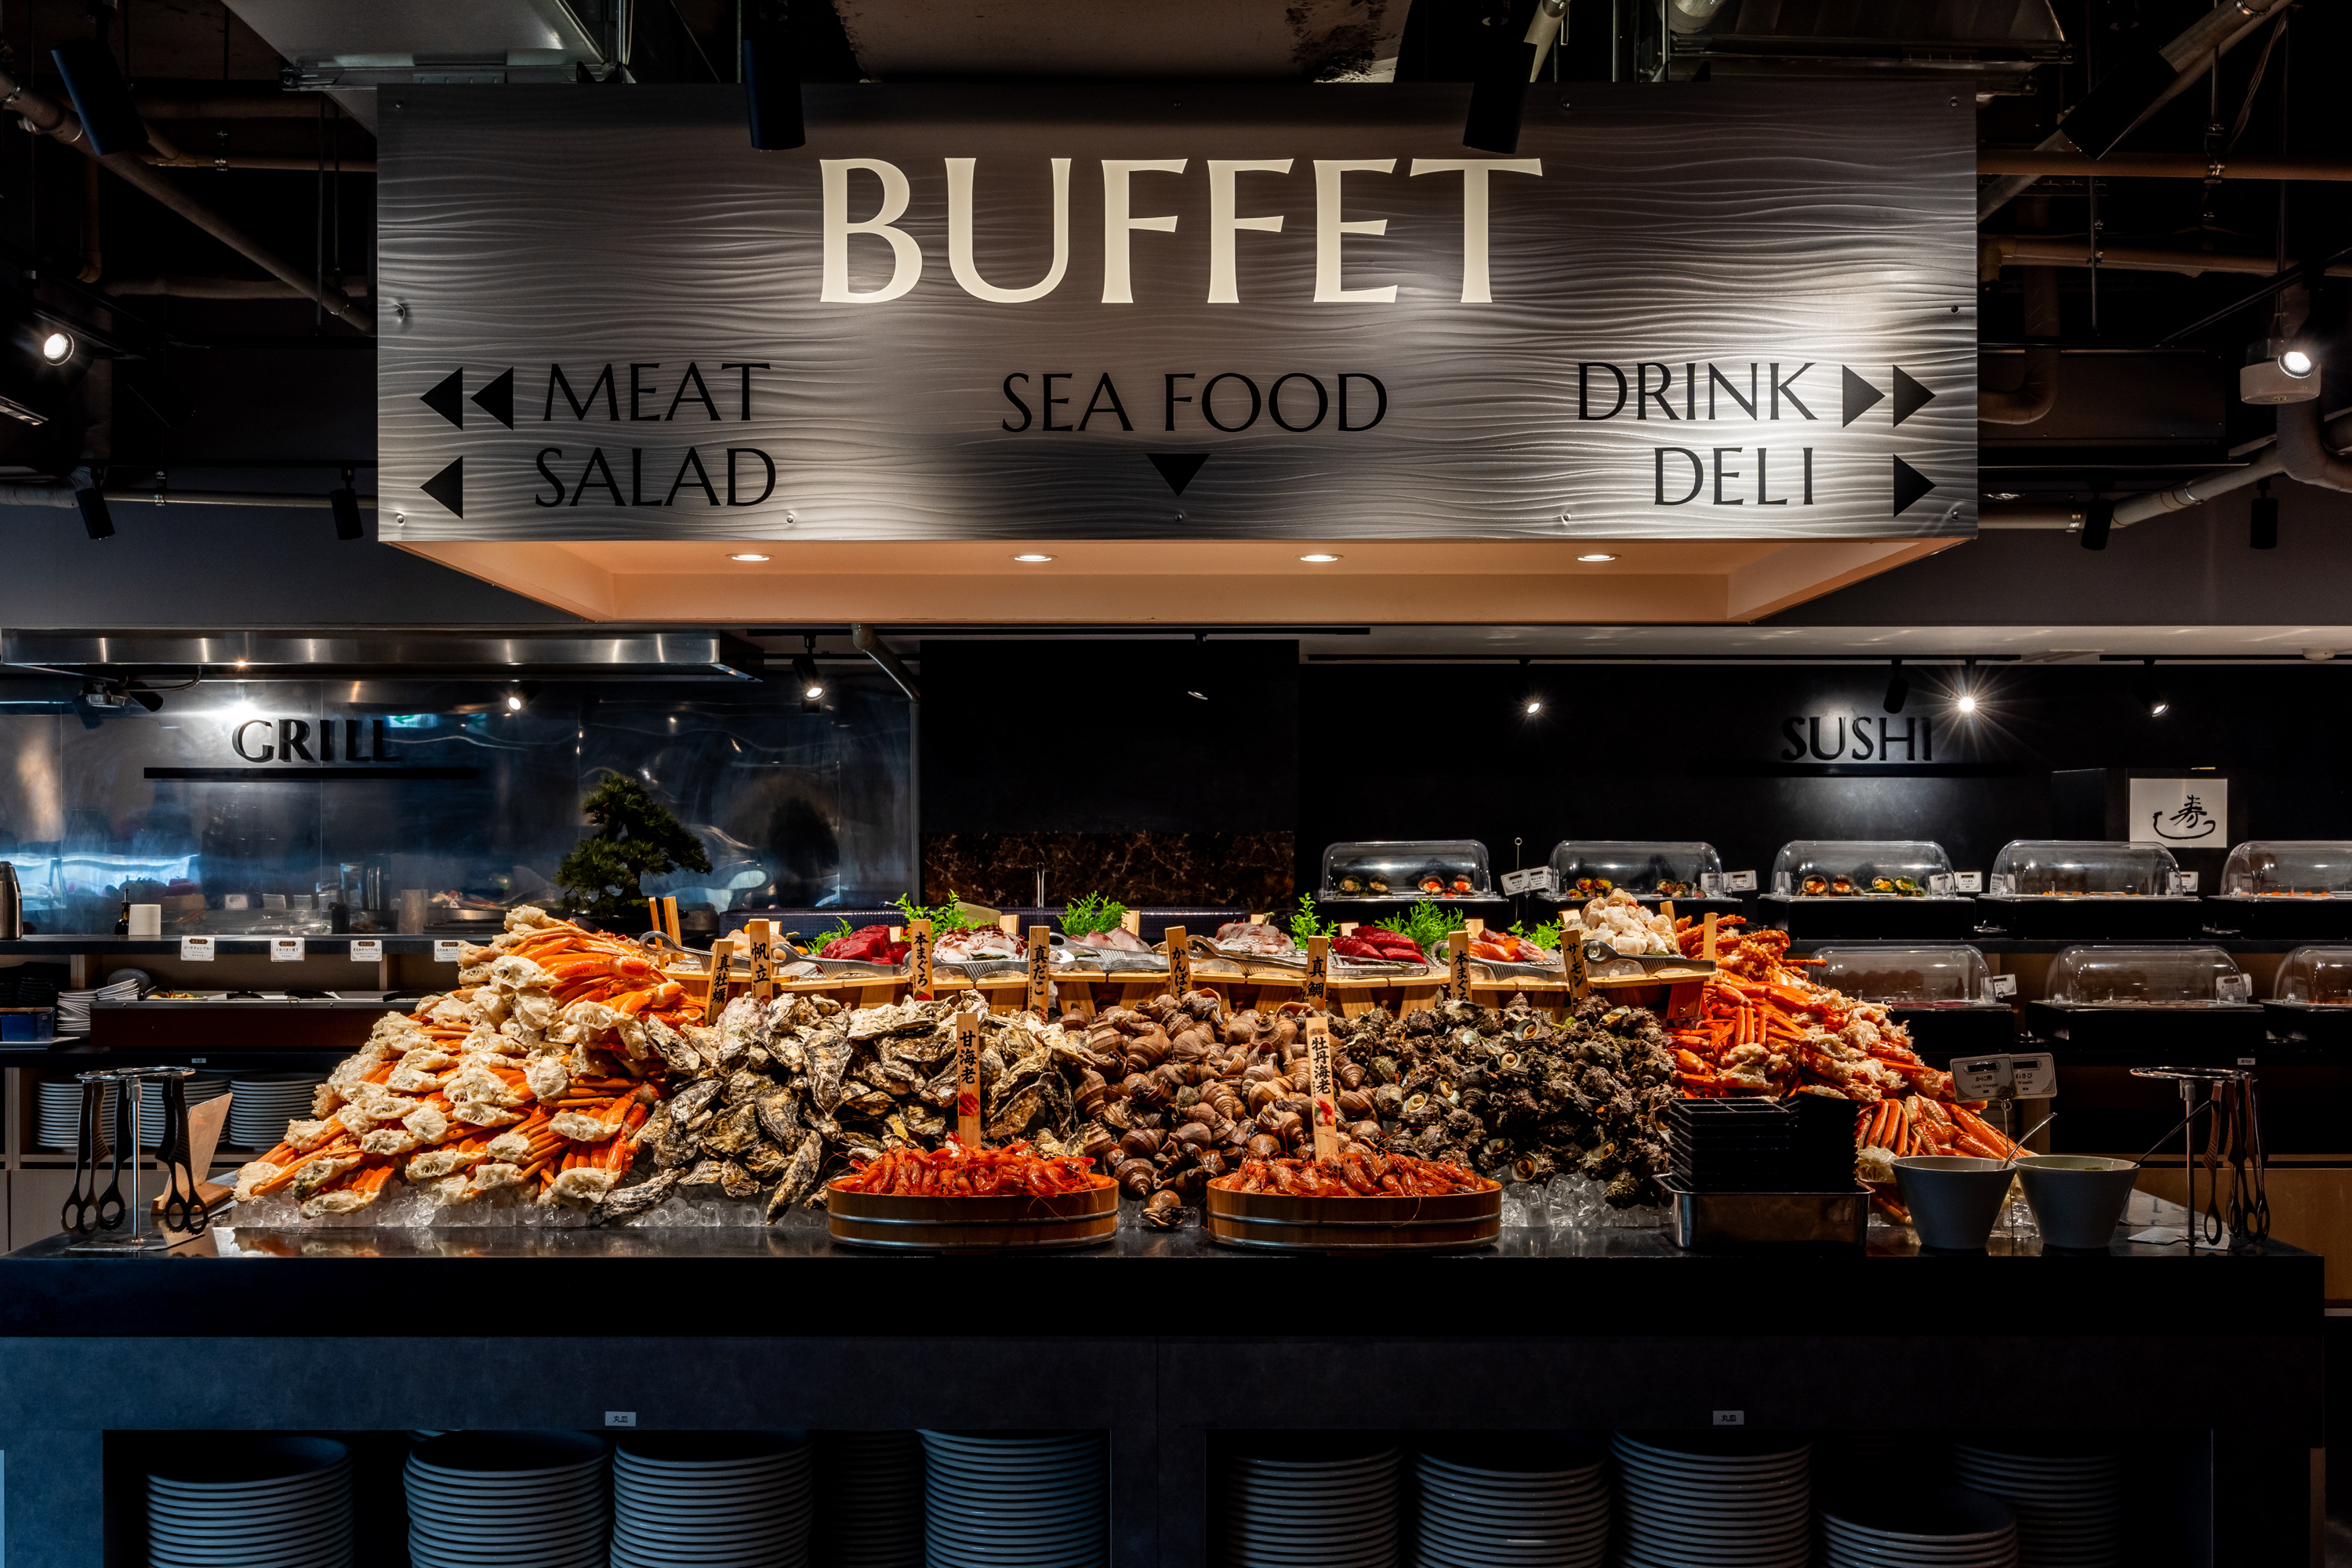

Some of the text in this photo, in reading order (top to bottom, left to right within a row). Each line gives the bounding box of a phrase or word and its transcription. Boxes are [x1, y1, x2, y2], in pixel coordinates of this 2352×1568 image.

[819, 158, 1542, 304] BUFFET
[543, 362, 771, 421] MEAT
[1002, 372, 1388, 433] SEA FOOD
[1578, 362, 1819, 421] DRINK
[535, 447, 776, 507] SALAD
[1654, 447, 1813, 506] DELI
[232, 719, 398, 764] GRILL
[1781, 717, 1933, 761] SUSHI
[711, 953, 731, 1004] 真牡蠣
[751, 942, 771, 984] 帆立
[913, 931, 930, 987] 本まぐろ
[1032, 945, 1048, 996] 真だこ
[1308, 956, 1326, 999] 真鯛
[1566, 942, 1584, 988] サーモン
[959, 1029, 977, 1084] 甘海老
[1312, 1036, 1331, 1094] 牡丹海老
